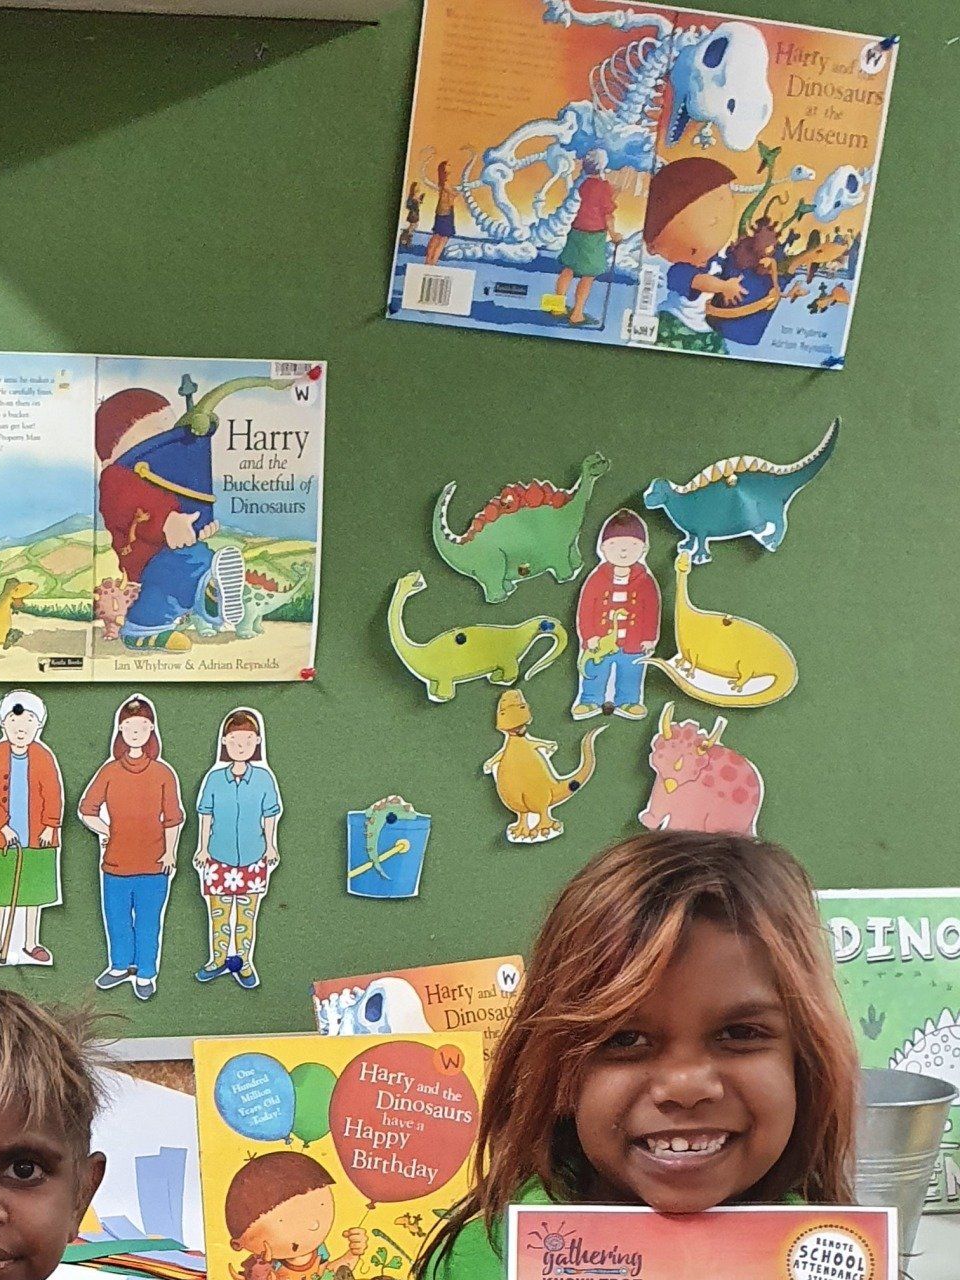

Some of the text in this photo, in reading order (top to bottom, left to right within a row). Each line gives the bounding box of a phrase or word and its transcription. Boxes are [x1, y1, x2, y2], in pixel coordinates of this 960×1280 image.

[776, 41, 856, 75] Harry and
[786, 74, 884, 105] Dinosaurs
[824, 106, 843, 120] the
[782, 116, 868, 148] Museum
[295, 386, 309, 401] W
[226, 419, 309, 459] Harry
[240, 454, 287, 469] and the
[223, 474, 314, 494] Bucketful of
[231, 496, 306, 514] Dinosaurs
[115, 658, 280, 672] Ian Whybrow & Adrian Reynolds
[502, 970, 516, 985] W
[425, 984, 473, 1004] Harry
[478, 984, 497, 999] and
[440, 1052, 460, 1070] W
[232, 1074, 269, 1094] Hundred
[237, 1069, 255, 1079] One
[359, 1062, 462, 1101] Harry and the
[241, 1089, 271, 1103] Million
[263, 1095, 280, 1107] Old
[376, 1090, 472, 1123] Dinosaurs
[382, 1112, 424, 1131] have a
[344, 1117, 410, 1149] Happy
[351, 1148, 438, 1184] Birthday
[817, 1238, 853, 1252] REMOTE
[542, 1237, 642, 1276] gathering
[799, 1245, 864, 1271] SCHOOL
